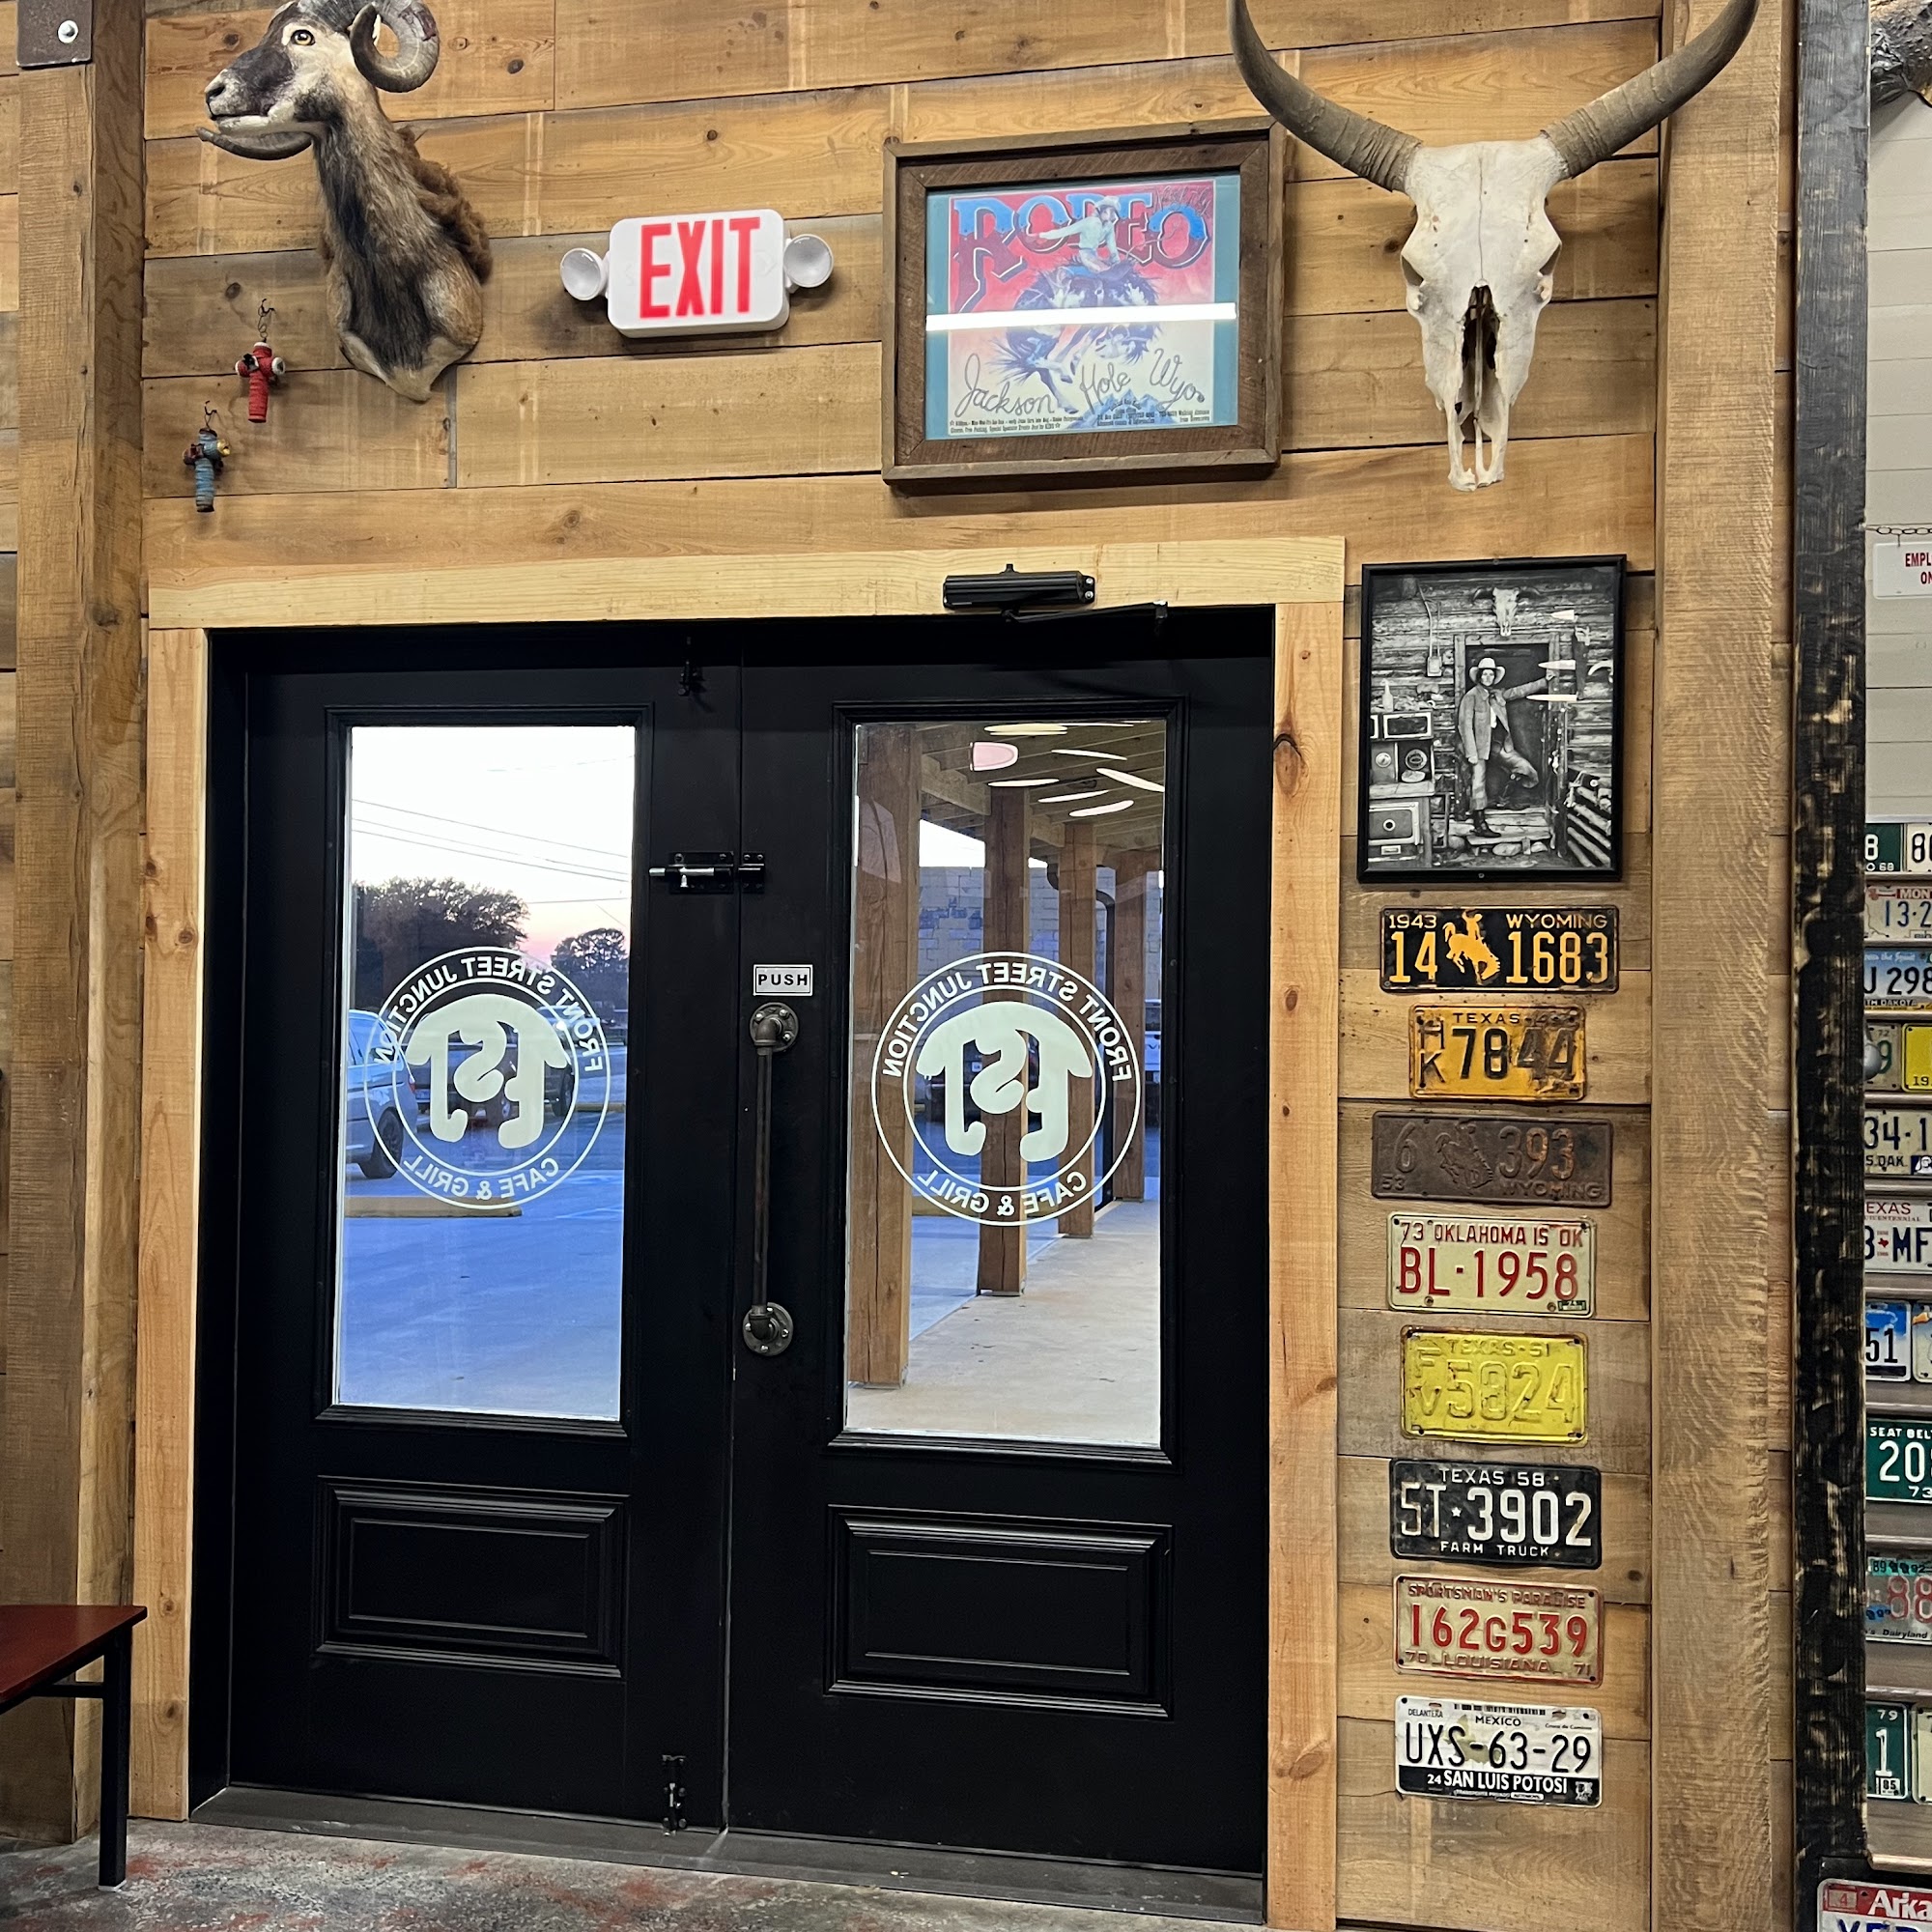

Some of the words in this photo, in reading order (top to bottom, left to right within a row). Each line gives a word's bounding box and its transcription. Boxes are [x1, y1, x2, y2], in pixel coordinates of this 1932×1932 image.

[952, 192, 1210, 314] RODEO
[639, 216, 760, 319] EXIT
[954, 353, 1055, 417] Jackson
[1079, 364, 1131, 414] Hole
[1912, 832, 1932, 864] 8
[1388, 914, 1437, 929] 1943
[1505, 913, 1608, 929] WYOMING
[1388, 930, 1438, 983] 14
[1505, 930, 1608, 984] 1683
[757, 974, 809, 986] PUSH
[1452, 1012, 1520, 1024] TEXAS
[1451, 1027, 1577, 1080] 7844
[1394, 1122, 1418, 1174] 6
[1498, 1125, 1575, 1180] 393
[1501, 1179, 1604, 1199] WYOMING
[1866, 1202, 1912, 1215] EXAS
[1401, 1221, 1424, 1240] 73
[1434, 1223, 1526, 1245] OKLAHOMA
[1533, 1227, 1549, 1246] IS
[1559, 1229, 1583, 1248] OK
[1446, 1359, 1576, 1425] 5824
[1869, 1426, 1903, 1437] SEAT
[1906, 1428, 1932, 1440] BEL
[1439, 1467, 1505, 1485] TEXAS
[1517, 1471, 1546, 1487] 58
[1908, 1485, 1932, 1498] 73
[1440, 1541, 1484, 1554] FARM
[1496, 1544, 1549, 1557] TRUCK
[1407, 1582, 1508, 1603] SPORTSMAN'S
[1512, 1590, 1586, 1608] PARADISE
[1410, 1604, 1589, 1658] 162G539
[1883, 1629, 1929, 1639] Dairyland
[1440, 1653, 1551, 1672] LOUISIANA
[1475, 1715, 1522, 1727] MEXICO
[1877, 1709, 1899, 1721] 79
[1406, 1722, 1591, 1774] UXS-63-29
[1427, 1774, 1442, 1784] 24
[1443, 1770, 1475, 1788] SAN
[1477, 1772, 1510, 1791] LUIS
[1513, 1776, 1568, 1794] POTOSI
